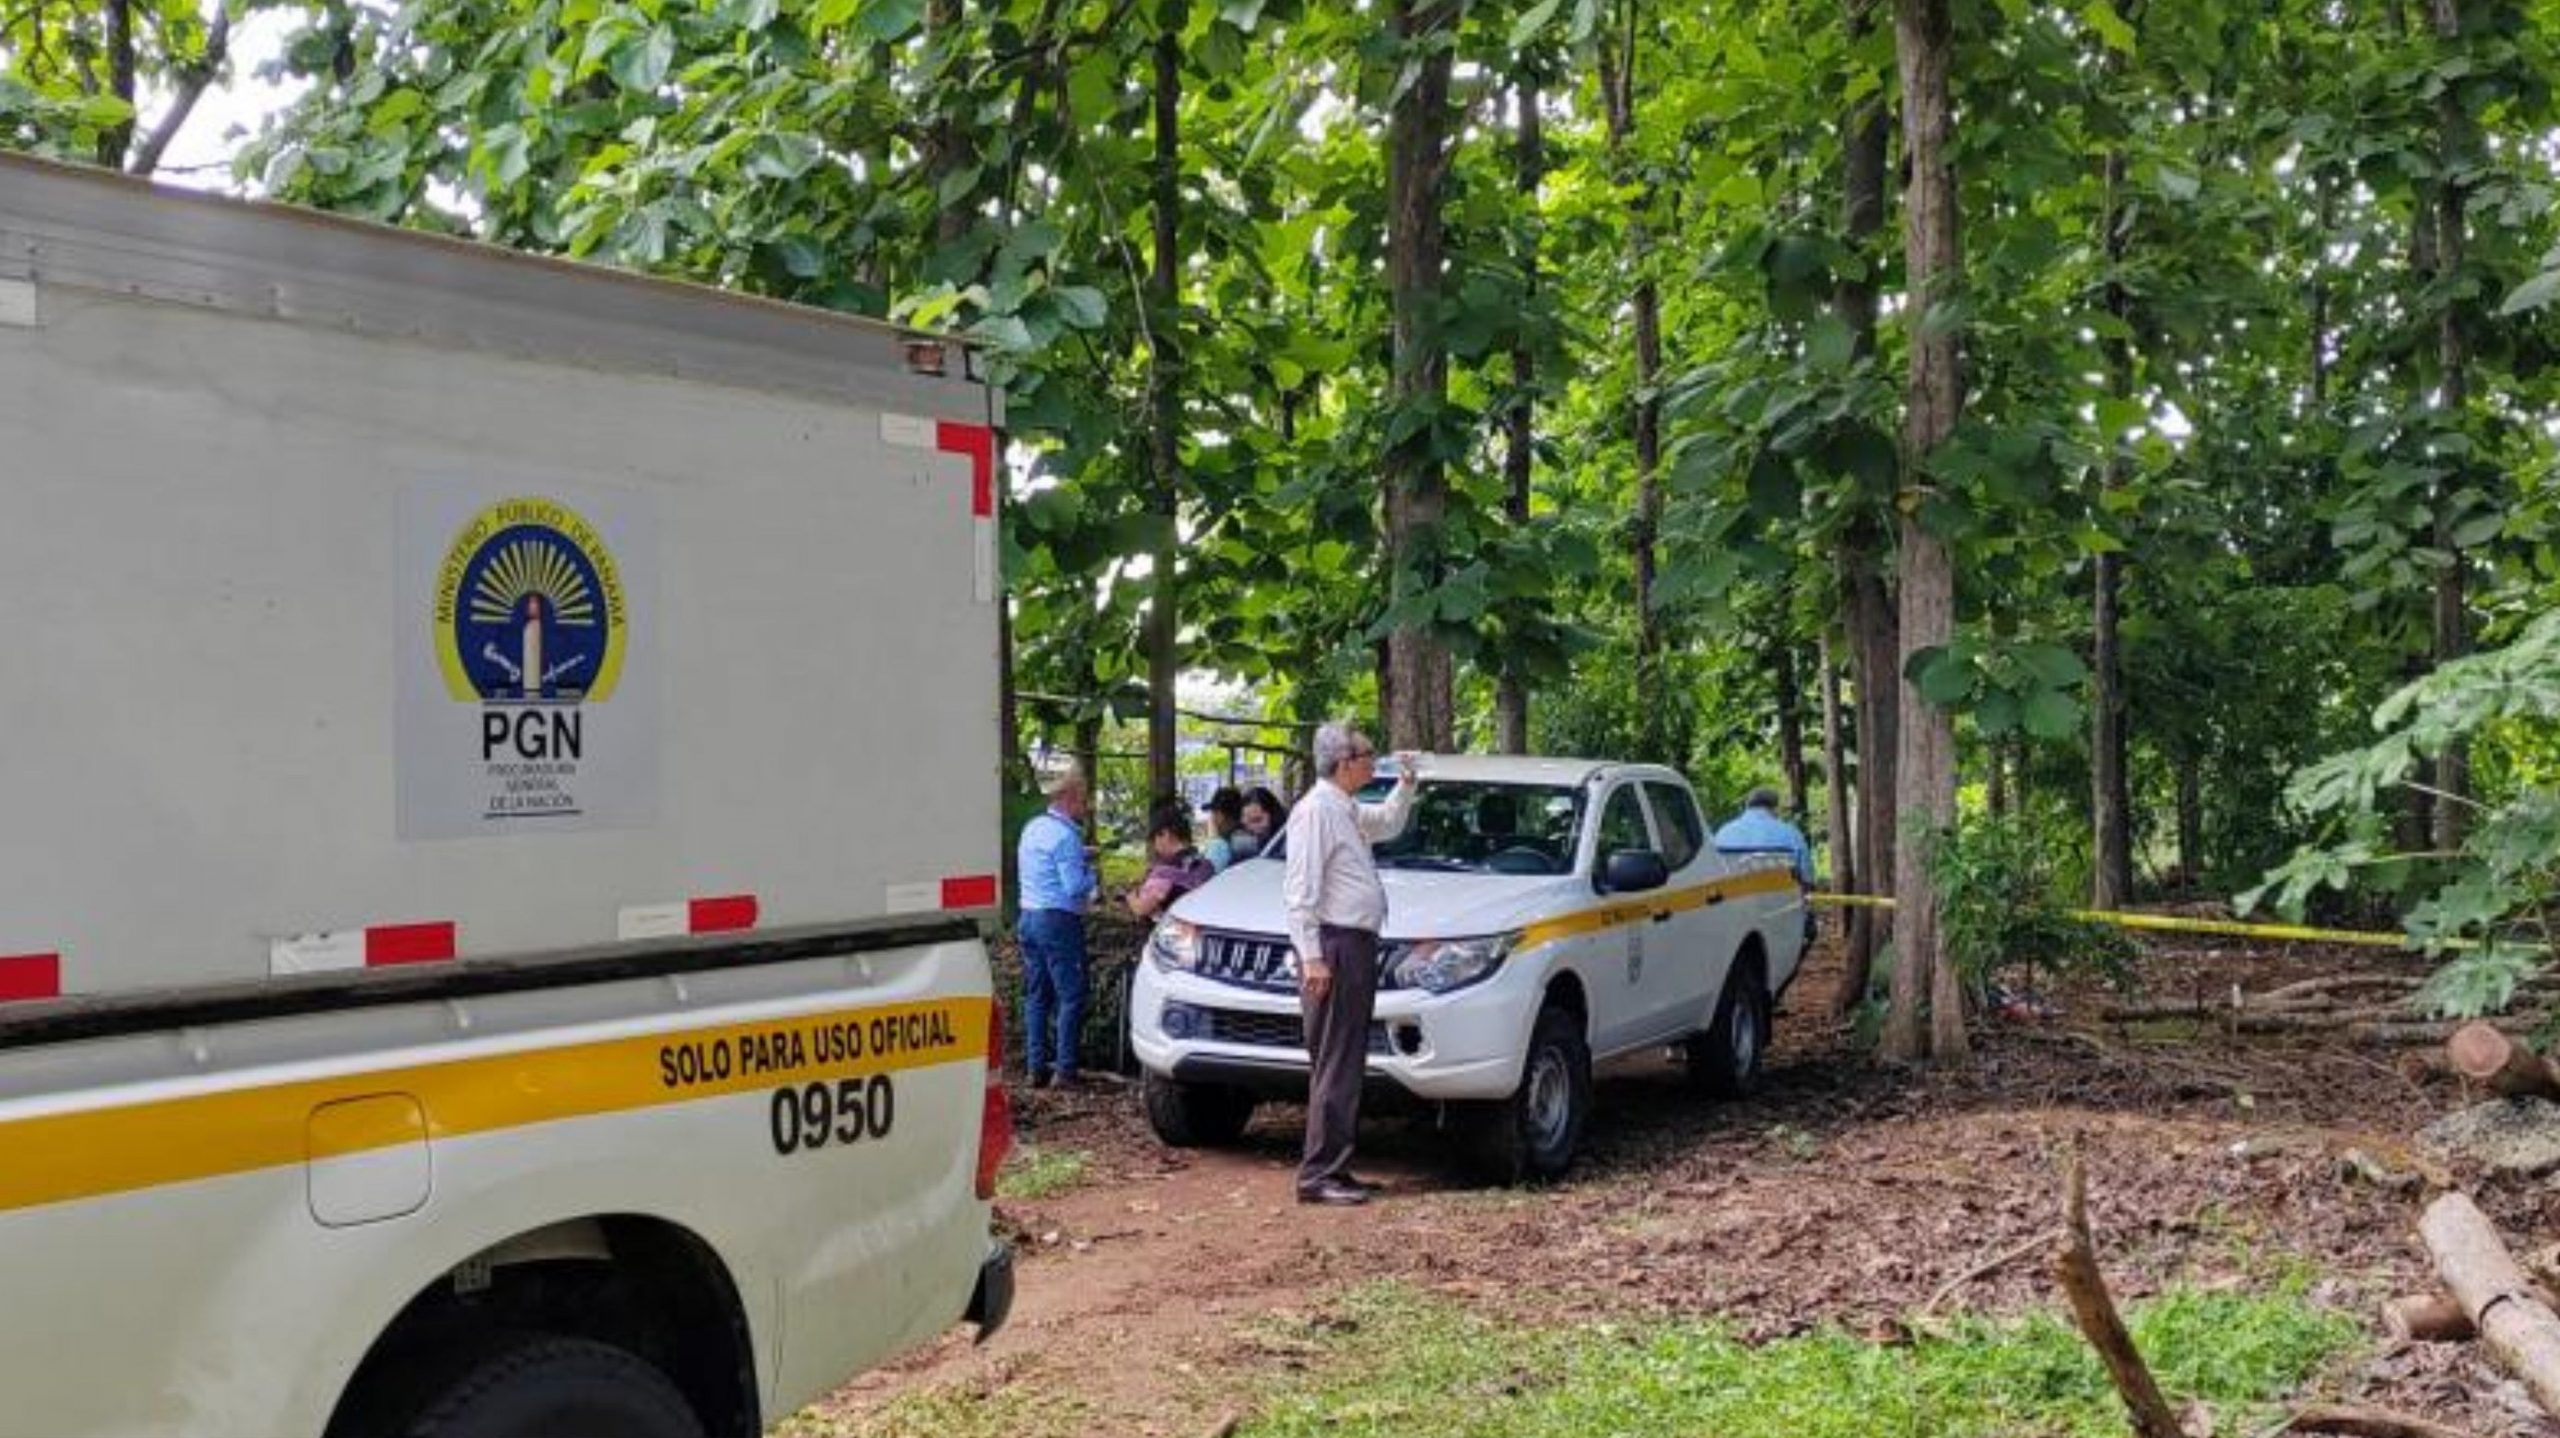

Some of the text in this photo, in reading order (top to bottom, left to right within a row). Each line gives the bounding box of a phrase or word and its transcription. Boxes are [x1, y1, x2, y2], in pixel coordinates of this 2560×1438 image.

[482, 710, 582, 761] PGN
[660, 1009, 956, 1087] SOLO PARA USO OFICIAL
[771, 1073, 895, 1155] 0950
